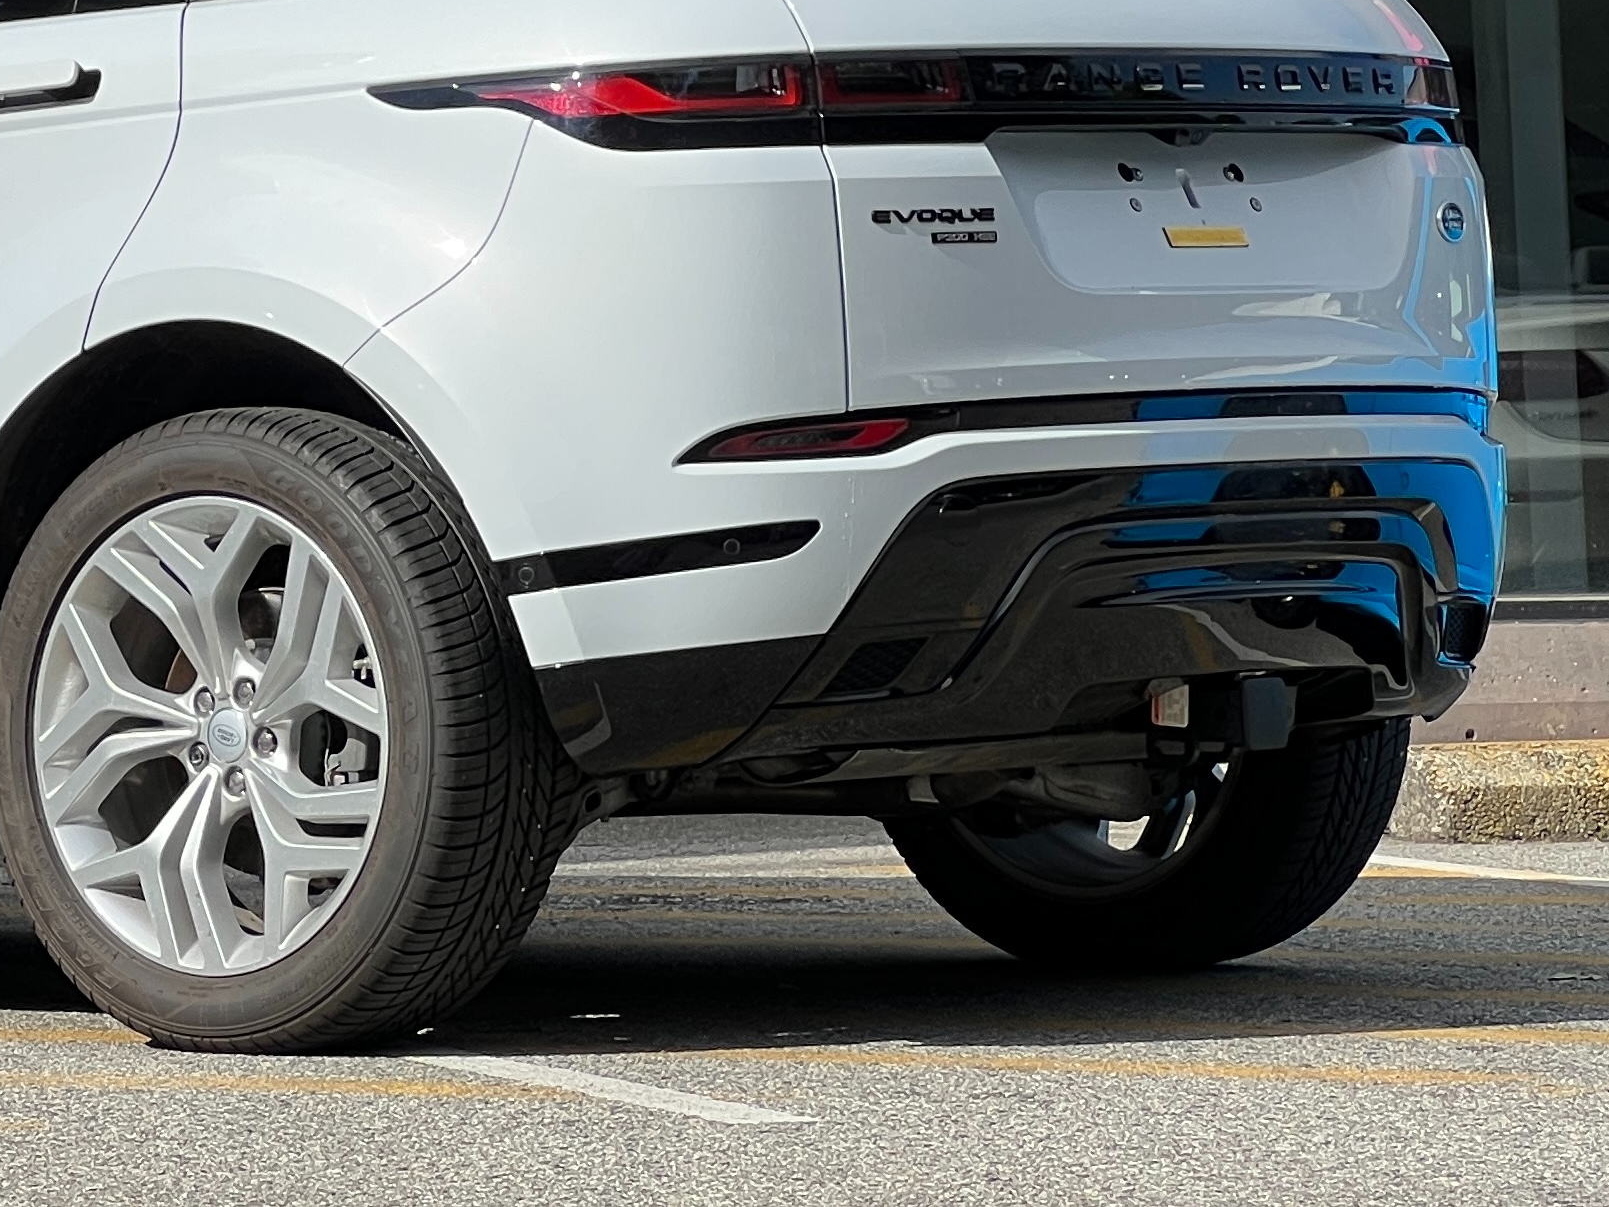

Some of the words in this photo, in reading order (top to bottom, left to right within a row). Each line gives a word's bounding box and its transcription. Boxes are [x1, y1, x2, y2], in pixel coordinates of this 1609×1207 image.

[990, 61, 1205, 93] RANGE
[1236, 62, 1397, 96] ROVER
[871, 207, 995, 225] EVOQUE
